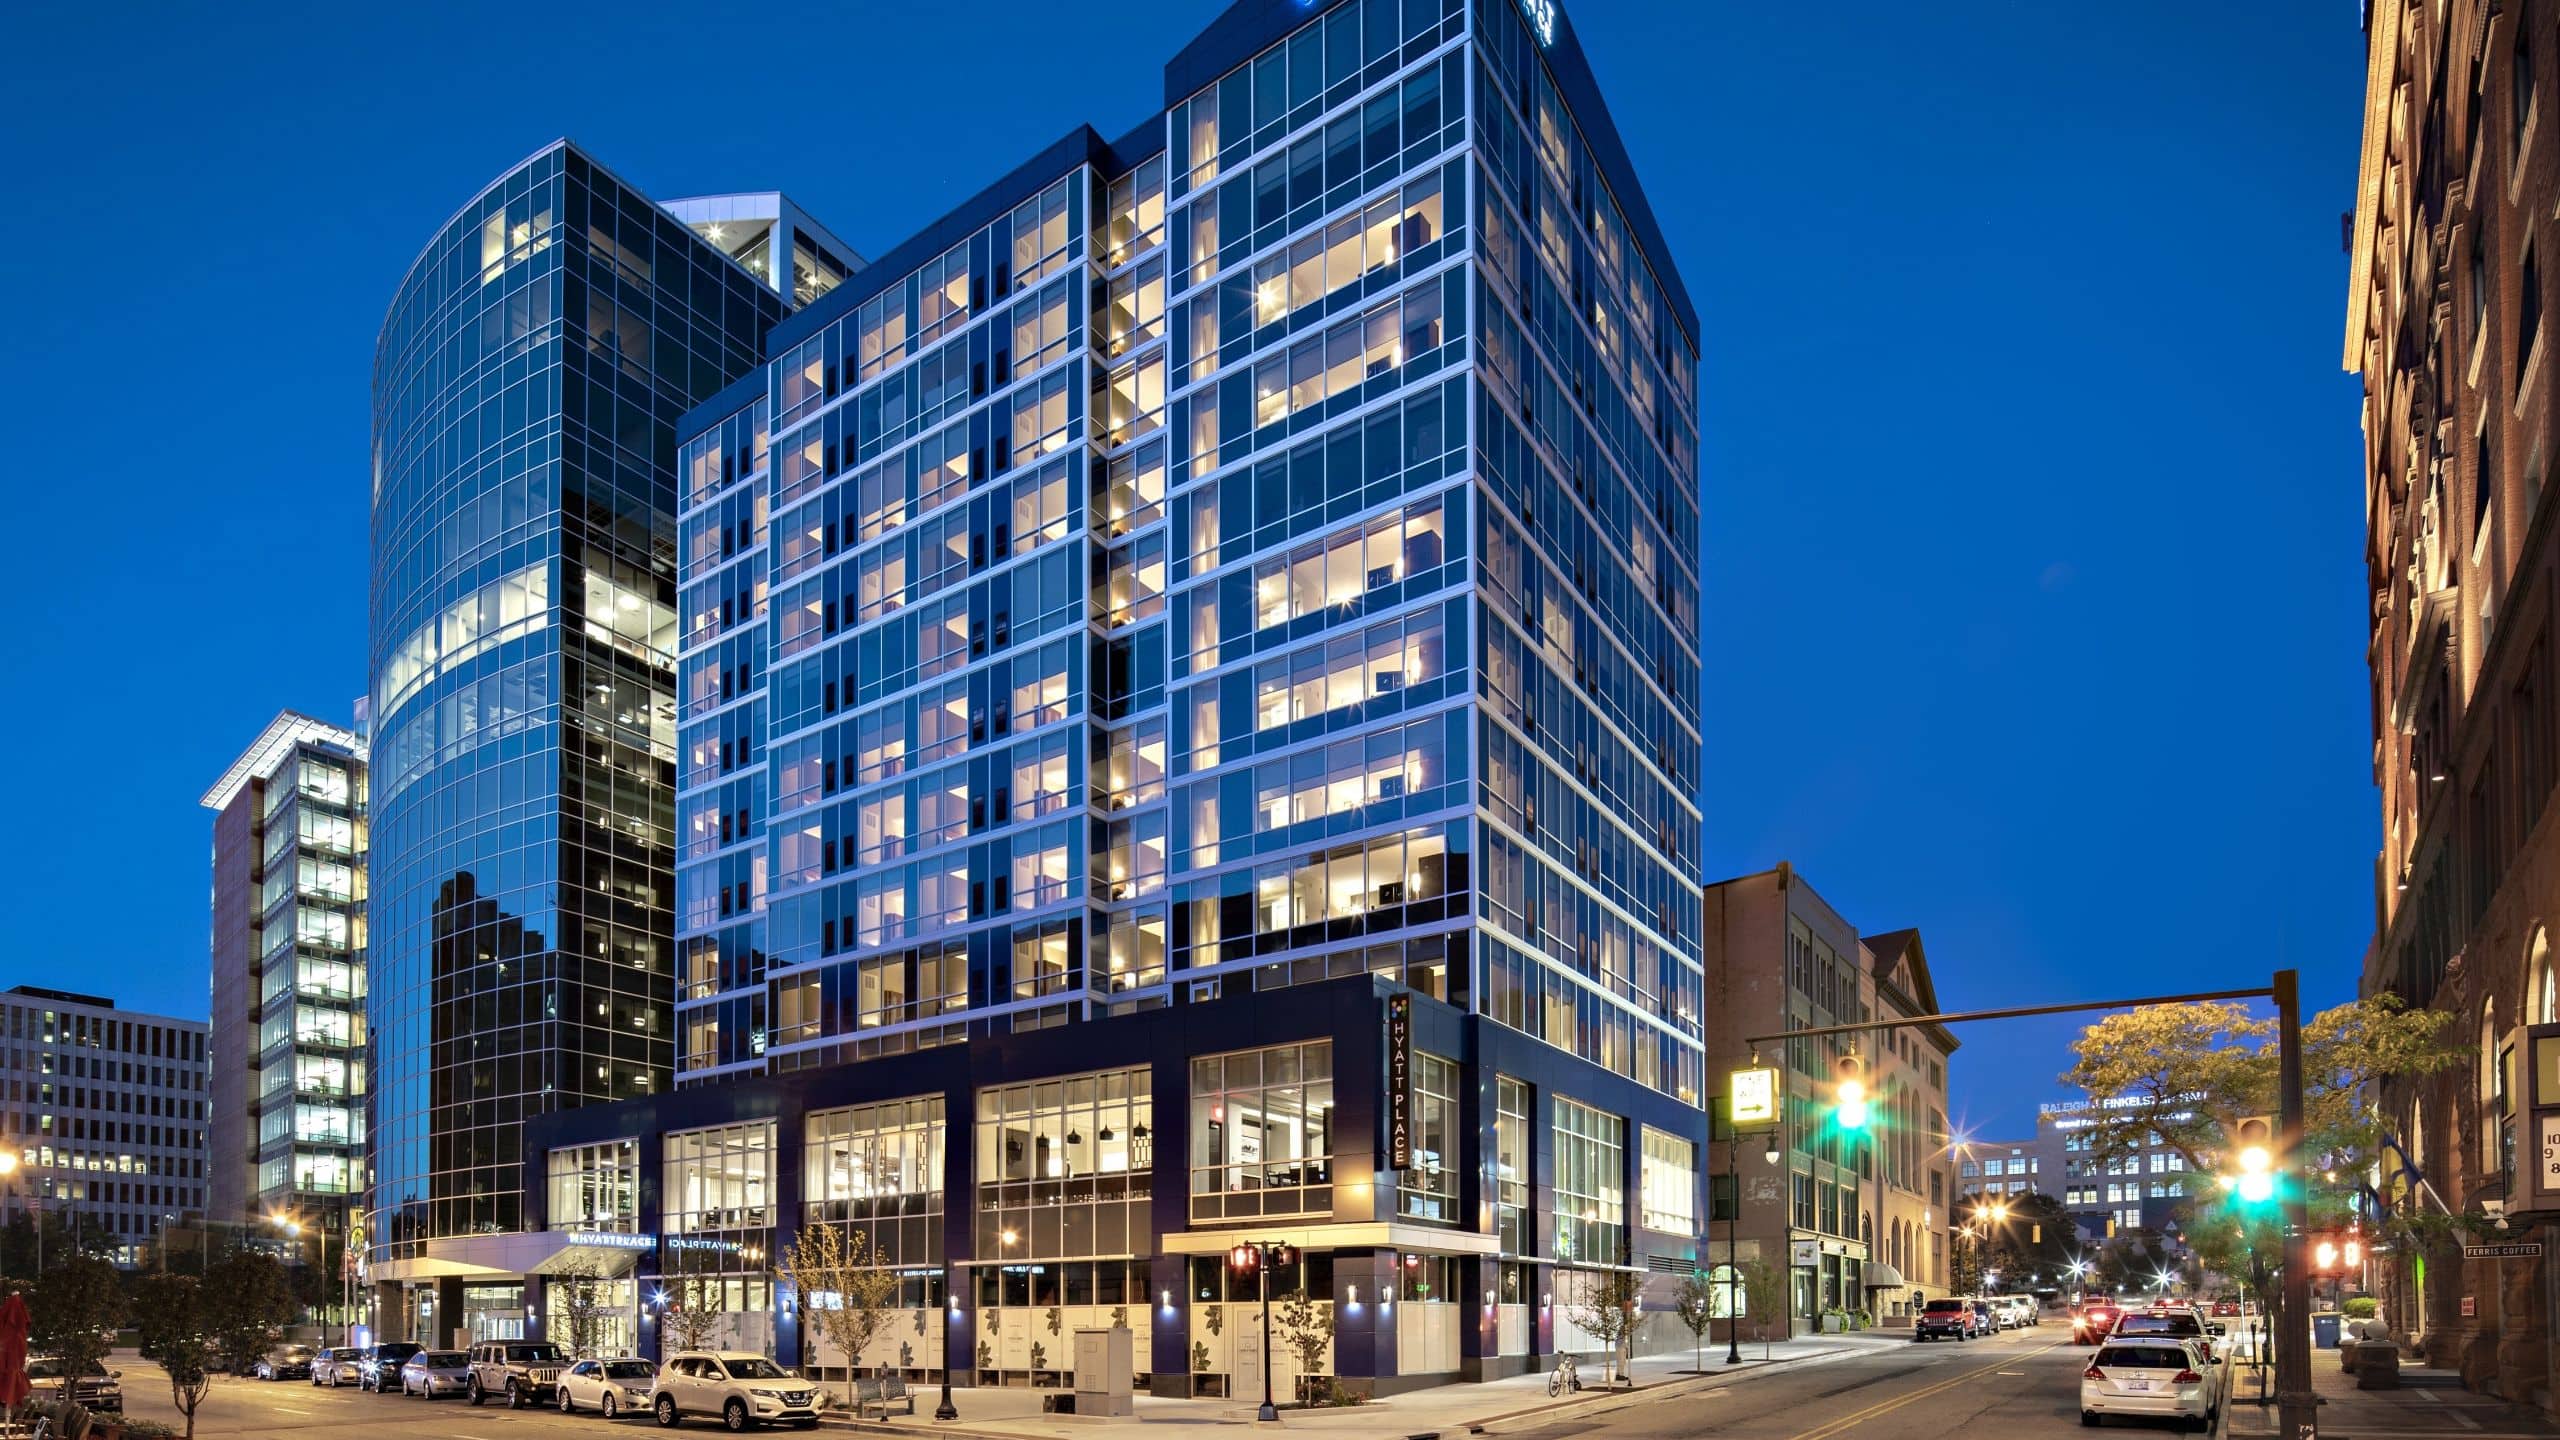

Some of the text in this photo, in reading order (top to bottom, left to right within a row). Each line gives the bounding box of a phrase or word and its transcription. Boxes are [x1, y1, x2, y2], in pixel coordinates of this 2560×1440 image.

[1394, 1023, 1405, 1162] HYATT PLACE
[2040, 1100, 2089, 1113] RALEIGH
[2544, 1148, 2554, 1159] 9
[2467, 1246, 2537, 1257] FERRIS COFFEE
